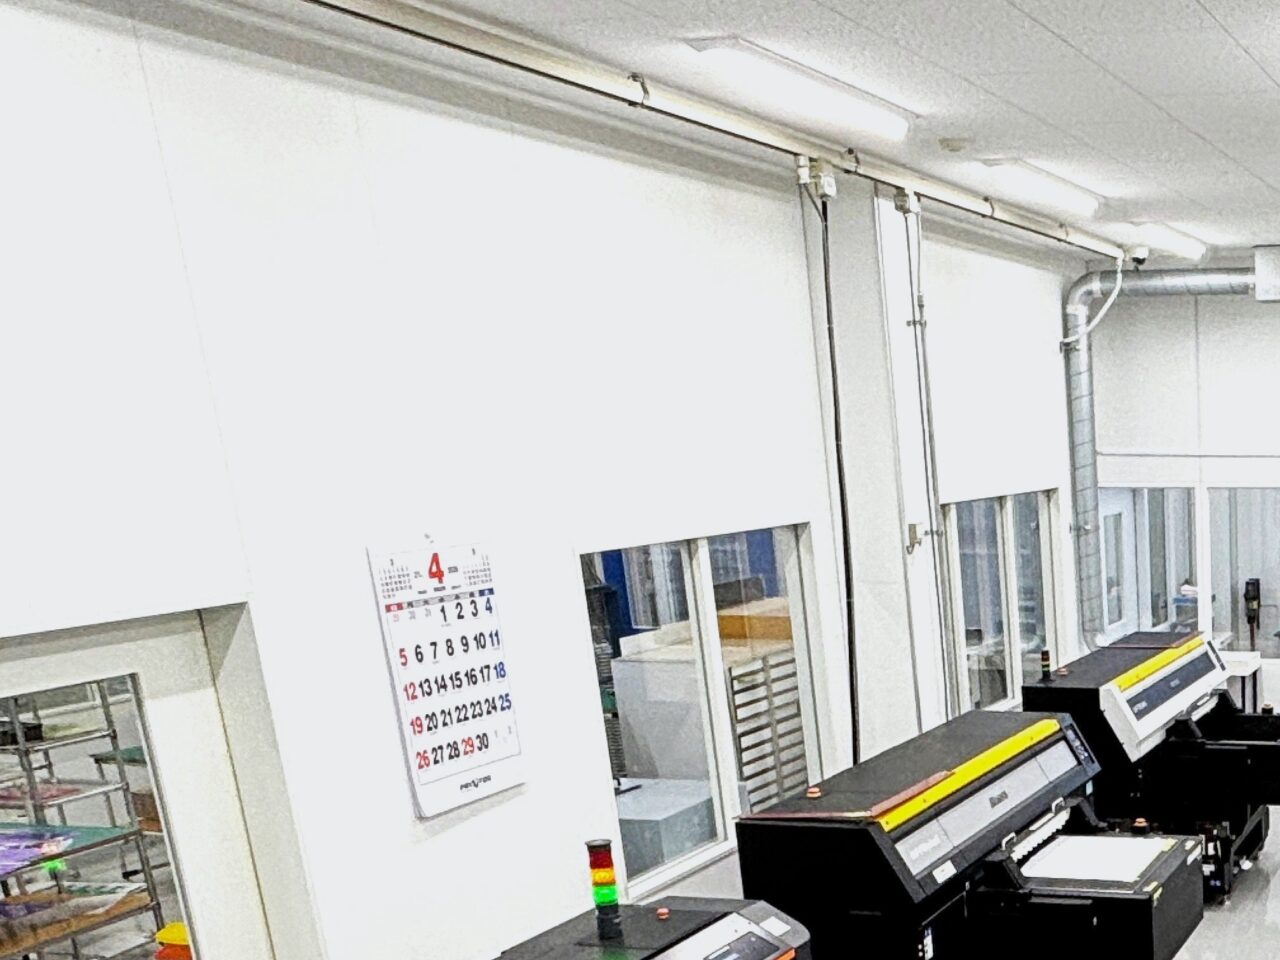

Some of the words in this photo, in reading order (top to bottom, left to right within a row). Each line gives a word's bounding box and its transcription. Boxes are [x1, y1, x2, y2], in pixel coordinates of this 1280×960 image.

[428, 552, 445, 584] 4
[440, 605, 447, 622] 1
[455, 602, 464, 619] 2
[470, 599, 479, 617] 3
[485, 597, 493, 614] 4
[398, 647, 408, 667] 5
[414, 644, 424, 663] 6
[430, 641, 438, 660] 7
[445, 638, 455, 656] 8
[460, 635, 470, 653] 9
[473, 631, 487, 650] 10
[488, 629, 501, 647] 11
[403, 682, 418, 701] 12
[418, 678, 433, 697] 13
[434, 674, 448, 694] 14
[448, 670, 463, 690] 15
[464, 667, 478, 686] 16
[479, 664, 491, 683] 17
[493, 661, 507, 679] 18
[410, 716, 424, 735] 19
[424, 711, 439, 732] 20
[440, 707, 453, 727] 21
[454, 703, 470, 723] 22
[470, 700, 484, 719] 23
[484, 696, 498, 715] 24
[498, 692, 512, 712] 25
[416, 749, 431, 770] 26
[431, 744, 444, 765] 27
[446, 740, 460, 760] 28
[461, 736, 475, 756] 29
[475, 732, 489, 752] 30
